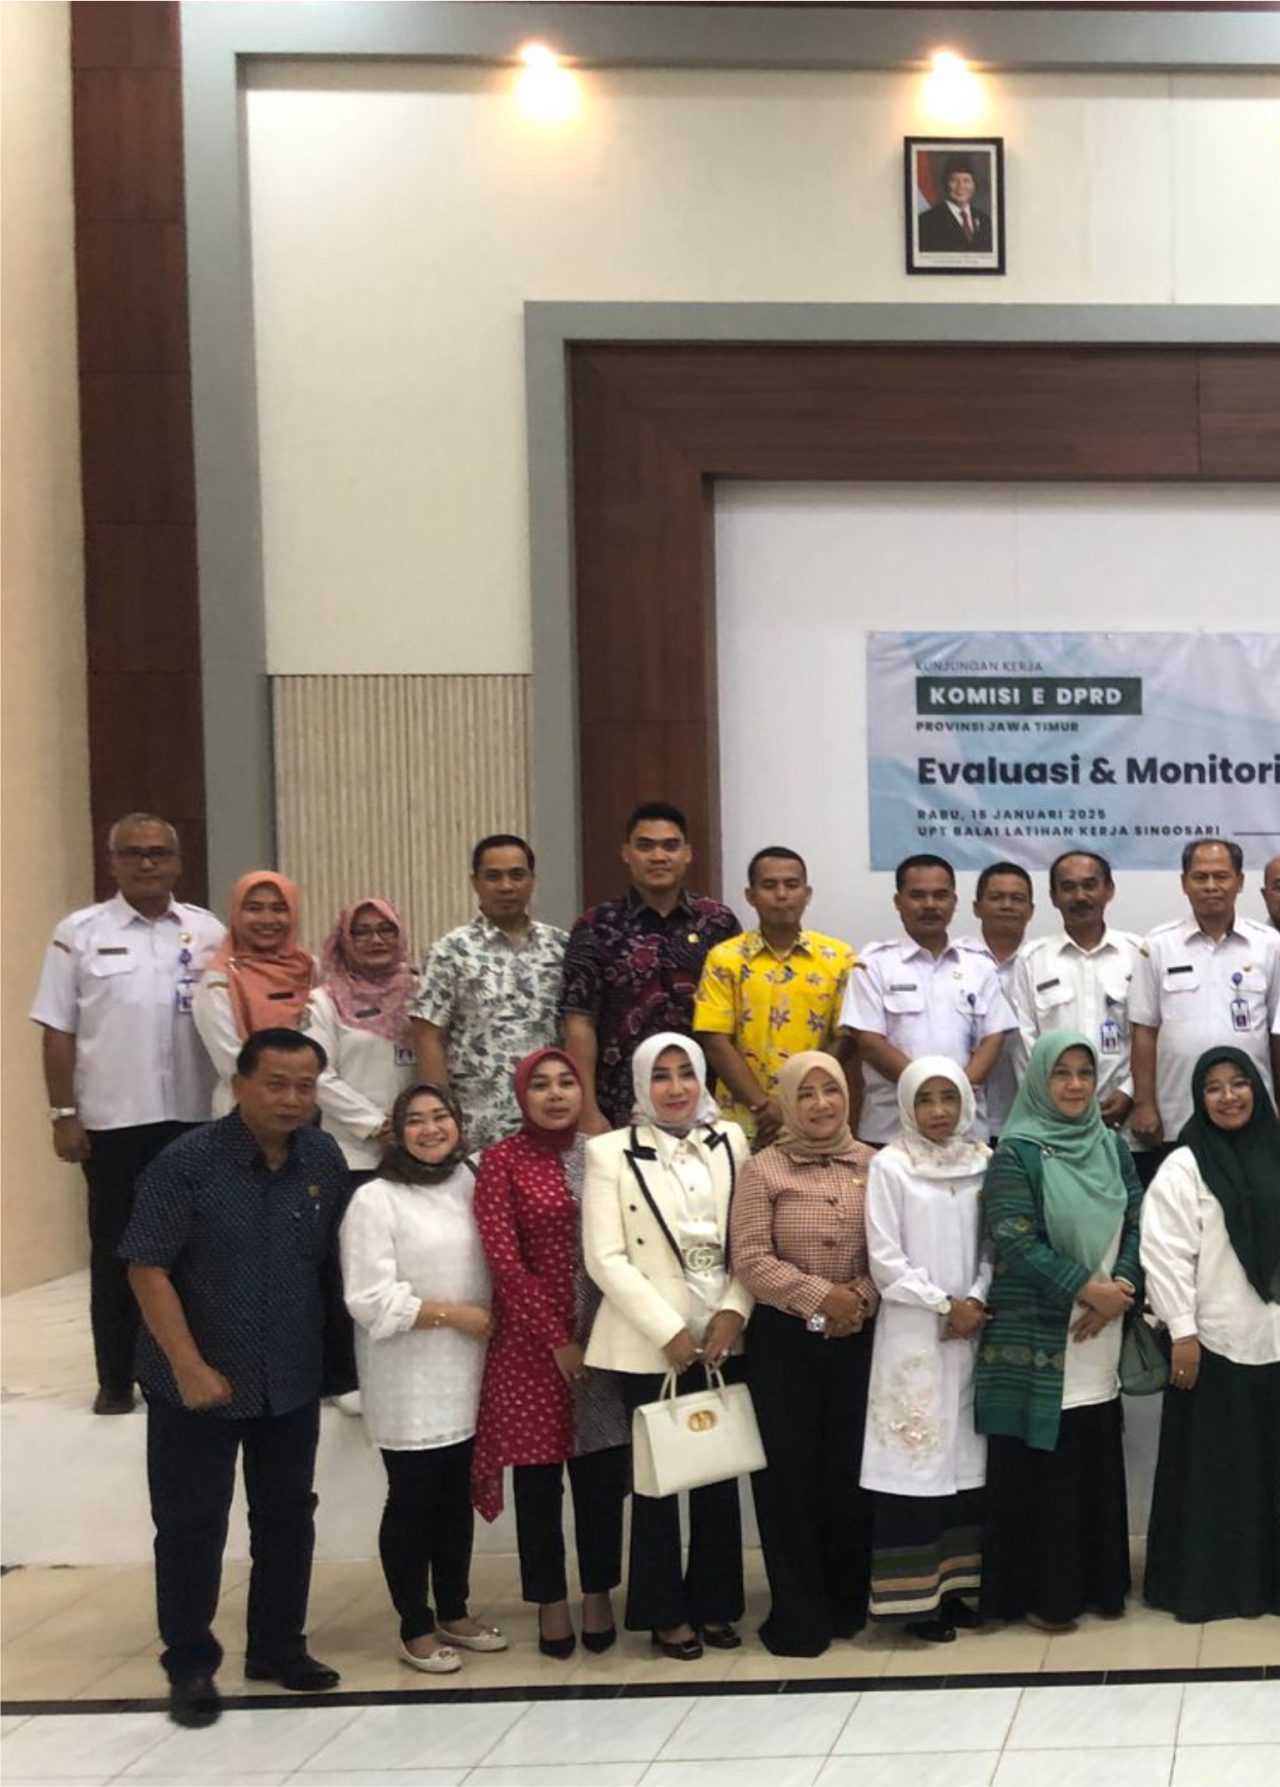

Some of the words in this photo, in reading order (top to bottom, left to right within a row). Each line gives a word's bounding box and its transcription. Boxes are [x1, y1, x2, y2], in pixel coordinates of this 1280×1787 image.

[915, 661, 998, 672] KUNJUNGAN
[1002, 660, 1043, 671] KERJA
[929, 687, 1020, 705] KOMISI
[1032, 687, 1045, 705] E
[1056, 687, 1122, 705] DPRD
[916, 722, 985, 732] PROVINSI
[987, 721, 1030, 732] JAWA
[1035, 721, 1079, 732] TIMUR
[917, 754, 1080, 785] Evaluasi
[1089, 757, 1117, 785] &
[916, 809, 965, 821] RABU,
[971, 809, 987, 820] 15
[993, 809, 1063, 820] JANUARI
[1069, 809, 1106, 820] 2025
[917, 826, 947, 837] UPT
[953, 826, 999, 837] BALAI
[1005, 826, 1073, 837] LATIHAN
[1079, 826, 1129, 836] KERJA
[1134, 825, 1220, 836] SINGOSARI
